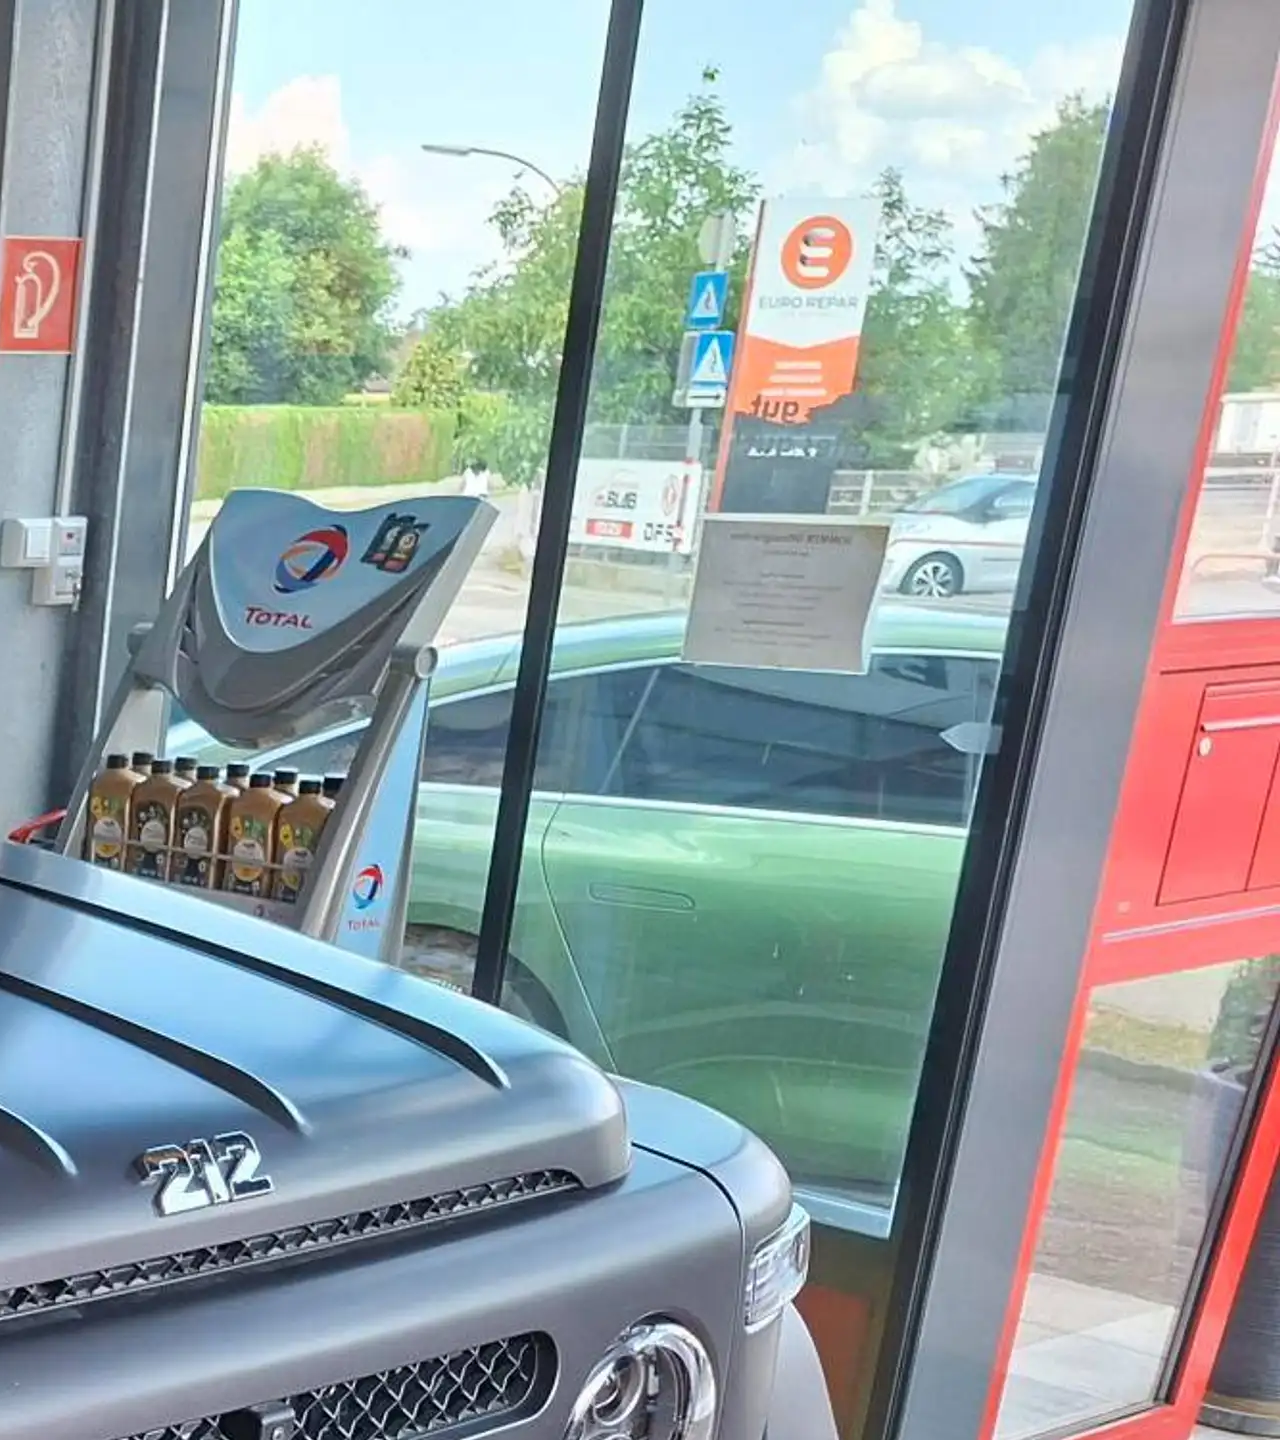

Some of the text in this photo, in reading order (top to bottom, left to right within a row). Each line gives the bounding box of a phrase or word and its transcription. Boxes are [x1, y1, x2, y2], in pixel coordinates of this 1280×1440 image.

[758, 295, 859, 310] EURO REPAR
[244, 606, 314, 630] TOTAL
[139, 1130, 274, 1217] 212
